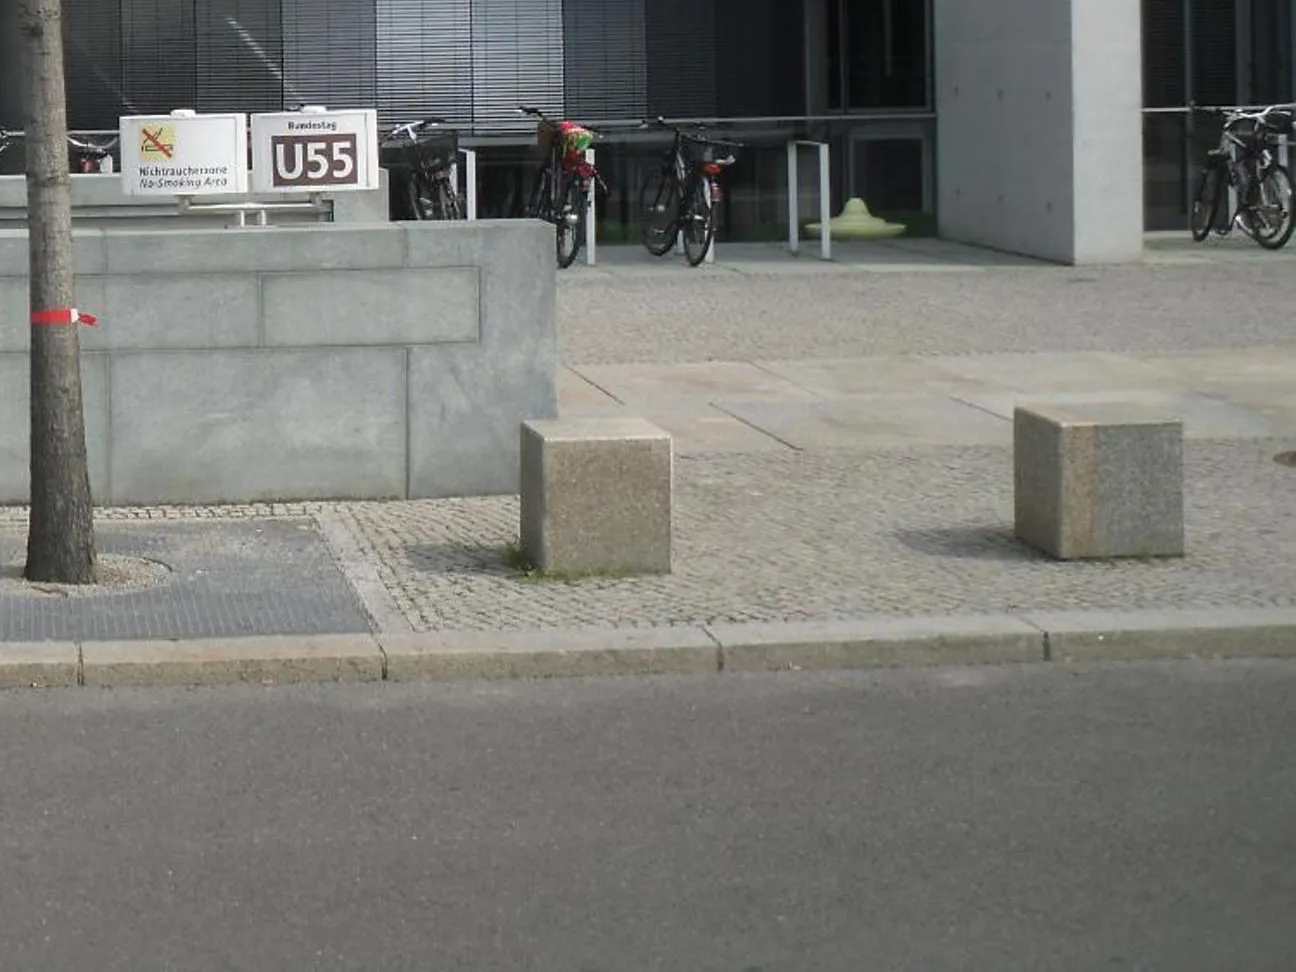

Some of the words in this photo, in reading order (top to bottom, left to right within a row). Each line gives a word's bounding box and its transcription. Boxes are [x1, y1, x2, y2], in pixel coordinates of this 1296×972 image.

[288, 120, 337, 131] Bundestag
[276, 141, 353, 179] U55
[139, 166, 227, 176] Nichtraucherzone
[204, 177, 227, 187] Area
